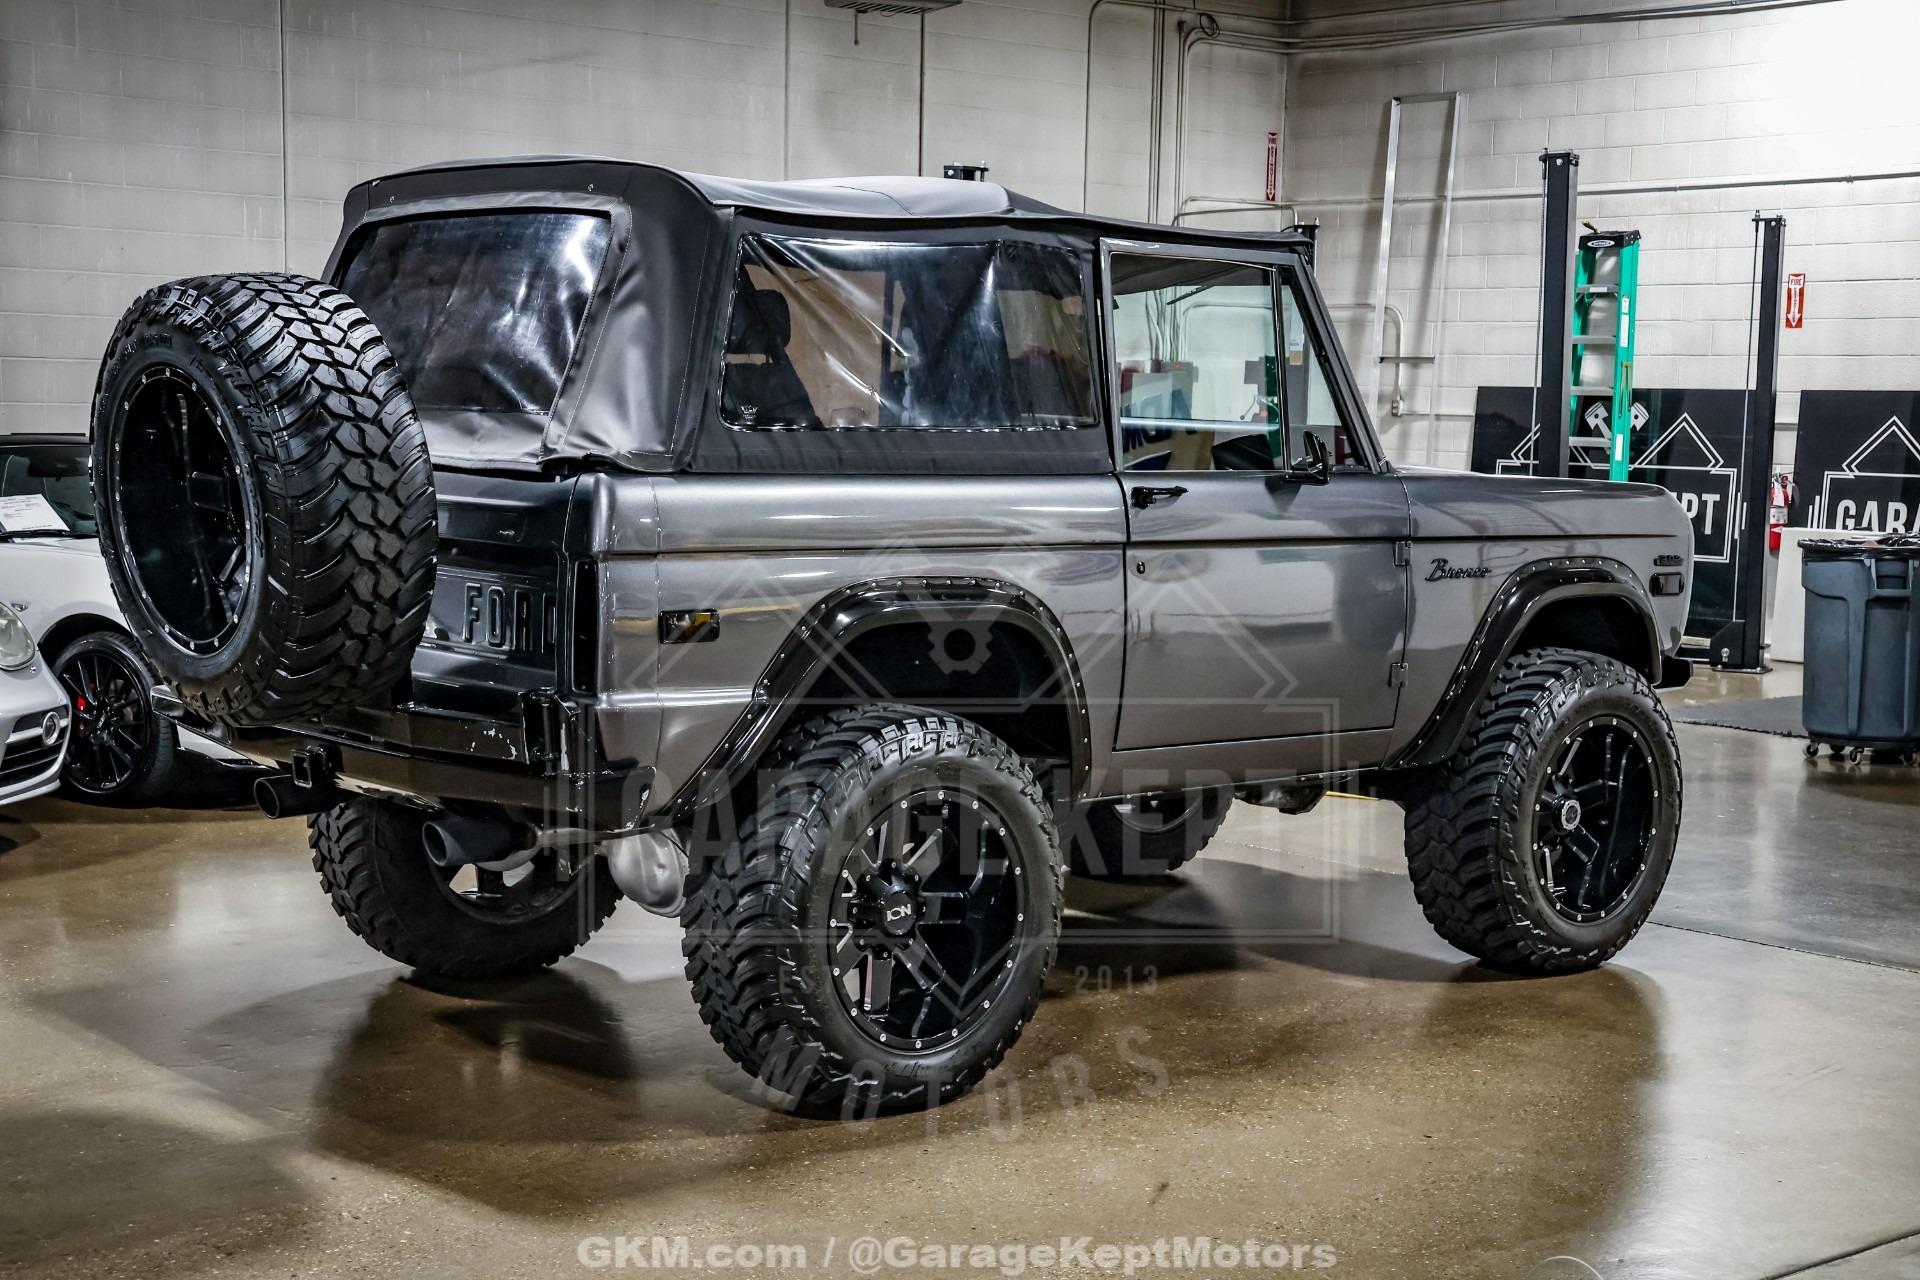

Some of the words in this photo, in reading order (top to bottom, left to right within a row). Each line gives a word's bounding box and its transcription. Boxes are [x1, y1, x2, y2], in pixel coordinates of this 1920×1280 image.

[1671, 491, 1721, 535] PT
[1424, 558, 1492, 582] Bronco
[886, 903, 912, 922] ION
